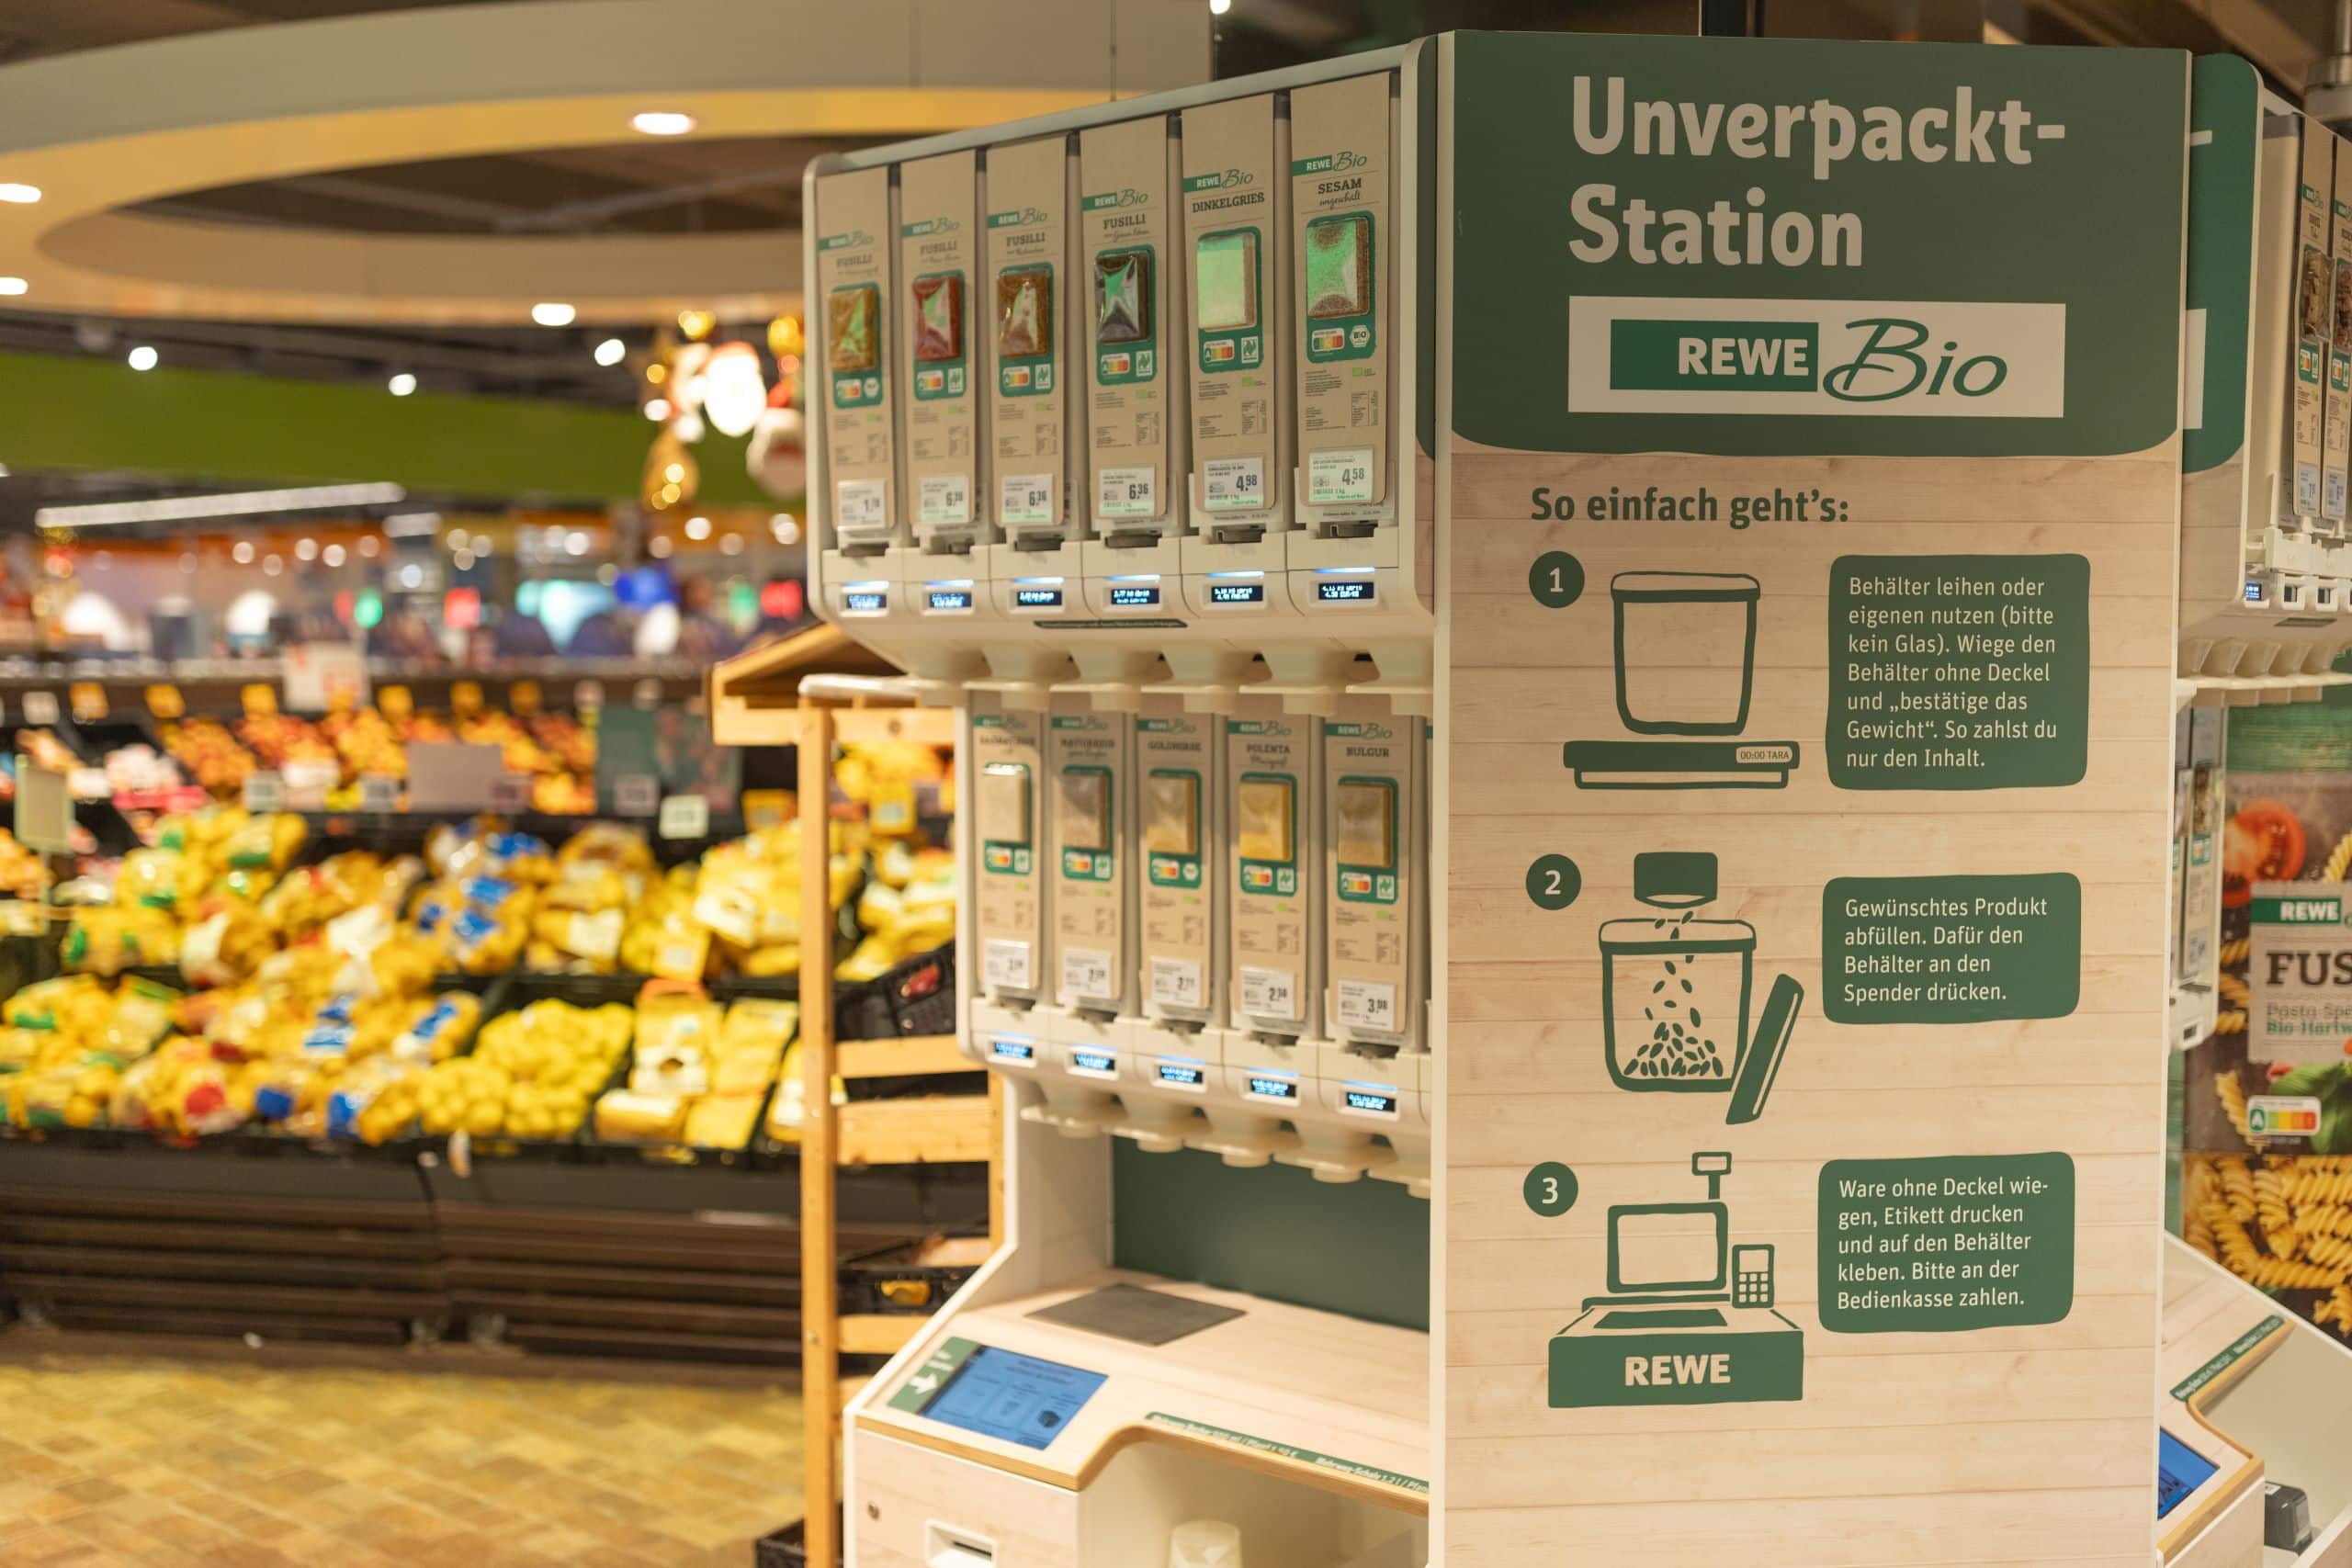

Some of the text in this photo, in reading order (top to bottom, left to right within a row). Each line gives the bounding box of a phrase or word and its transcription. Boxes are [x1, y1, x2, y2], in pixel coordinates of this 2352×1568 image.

[1572, 75, 2065, 179] Unverpackt-
[1306, 152, 1367, 172] REWE Bio
[1196, 169, 1253, 188] REWE Bio
[1317, 178, 1362, 195] SESAM
[1103, 214, 1146, 230] FUSILLI
[1568, 183, 1863, 267] Station
[1676, 318, 2007, 401] REWE Bio
[1531, 487, 1575, 522] So
[1587, 487, 1718, 522] einfach
[1549, 568, 1564, 592] 1
[1849, 577, 2044, 596] Behälter leihen oder
[1849, 604, 2053, 628] eigenen nutzen (bitte
[1849, 634, 2055, 657] kein Glas). Wiege den
[1849, 663, 2050, 682] Behälter ohne Deckel
[1847, 692, 2028, 714] und „bestätige das
[1847, 720, 2057, 739] Gewicht“. So zahlst du
[1740, 750, 1789, 760] 00:00 TARA
[1847, 749, 1985, 767] nur den Inhalt.
[1544, 870, 1562, 896] 2
[1845, 897, 2048, 917] Gewünschtes Produkt
[2280, 901, 2338, 920] REWE
[1845, 925, 2023, 945] abfüllen. Dafür den
[1845, 953, 1991, 974] Behälter an den
[2266, 952, 2352, 986] FUS
[1844, 982, 2007, 1006] Spender drücken.
[1543, 1178, 1558, 1204] 3
[1839, 1176, 2048, 1199] Ware ohne Deckel wie-
[1838, 1204, 2023, 1230] gen, Etikett drucken
[1838, 1232, 2031, 1254] und auf den Behälter
[1838, 1259, 2019, 1281] kleben. Bitte an der
[1838, 1288, 2024, 1310] Bedienkasse zahlen.
[1623, 1353, 1731, 1387] REWE
